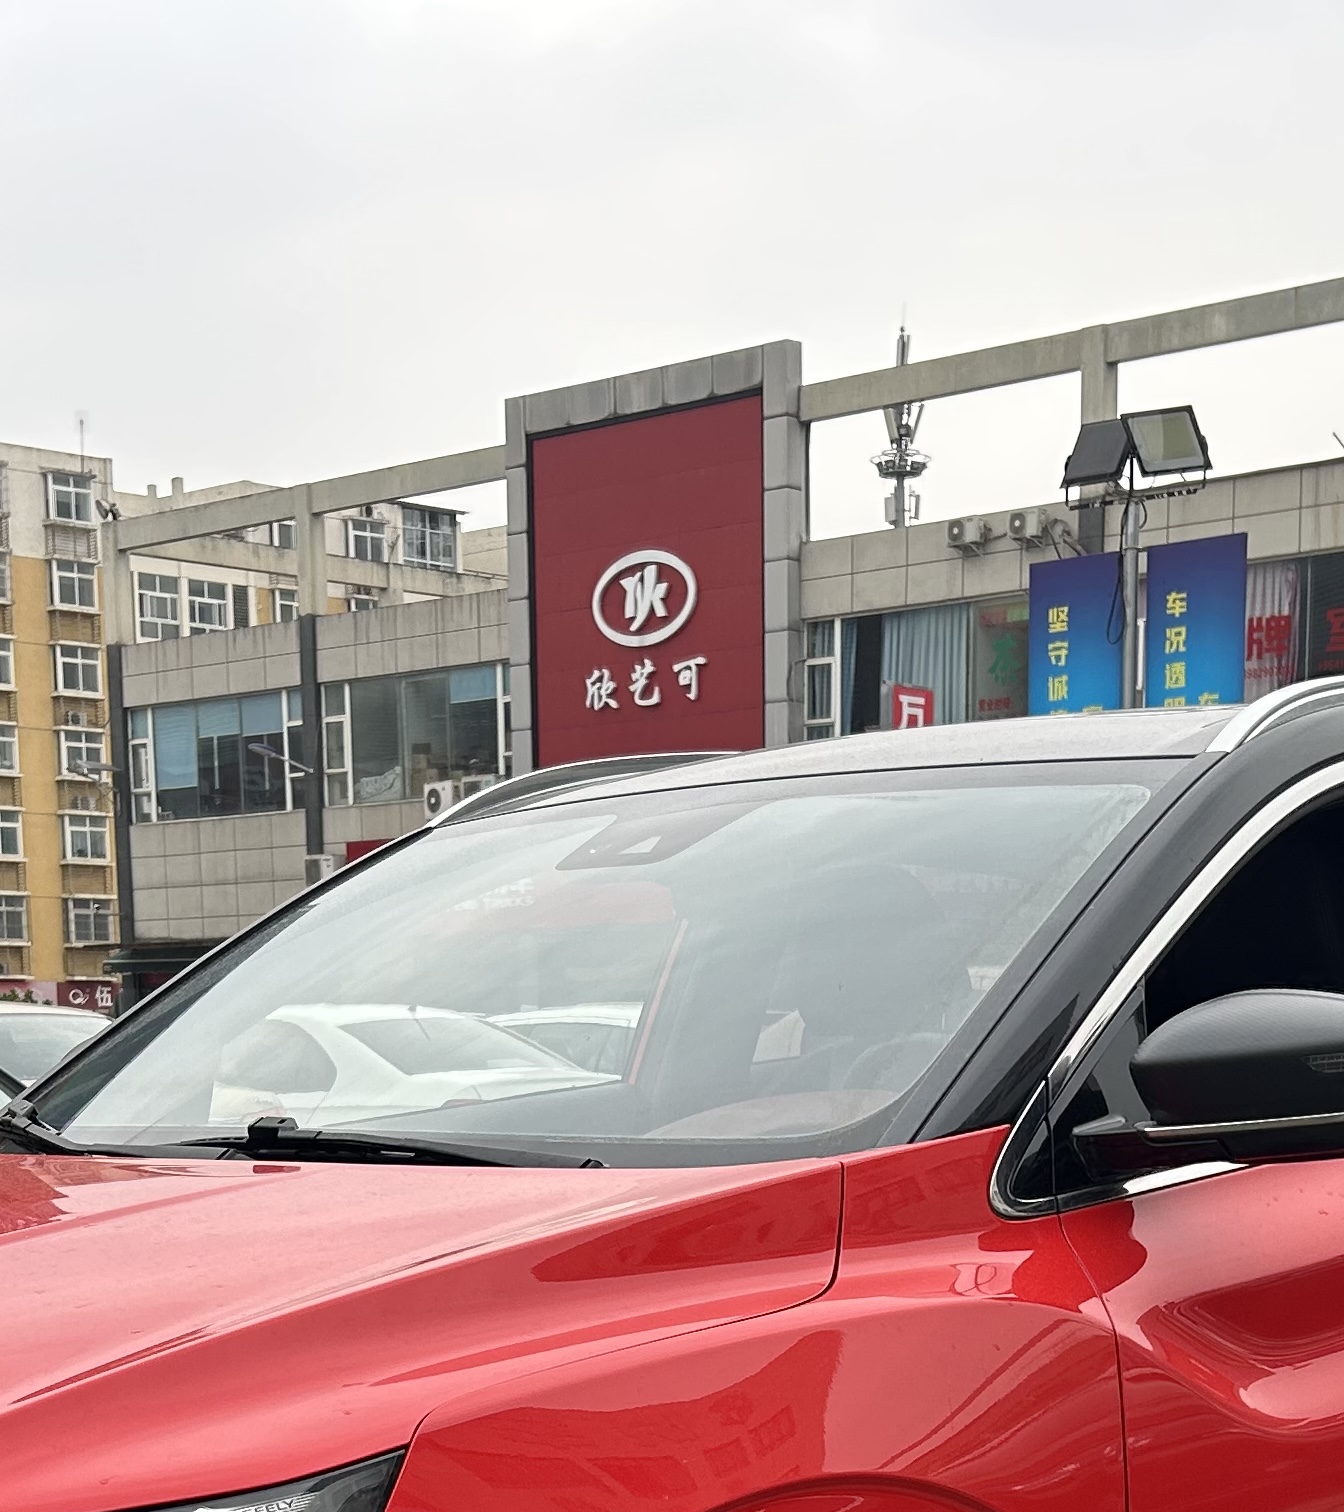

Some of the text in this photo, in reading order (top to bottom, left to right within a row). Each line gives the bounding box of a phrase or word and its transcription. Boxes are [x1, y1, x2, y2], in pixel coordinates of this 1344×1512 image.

[585, 656, 708, 711] 欣艺可
[1047, 605, 1070, 715] 坚守诚
